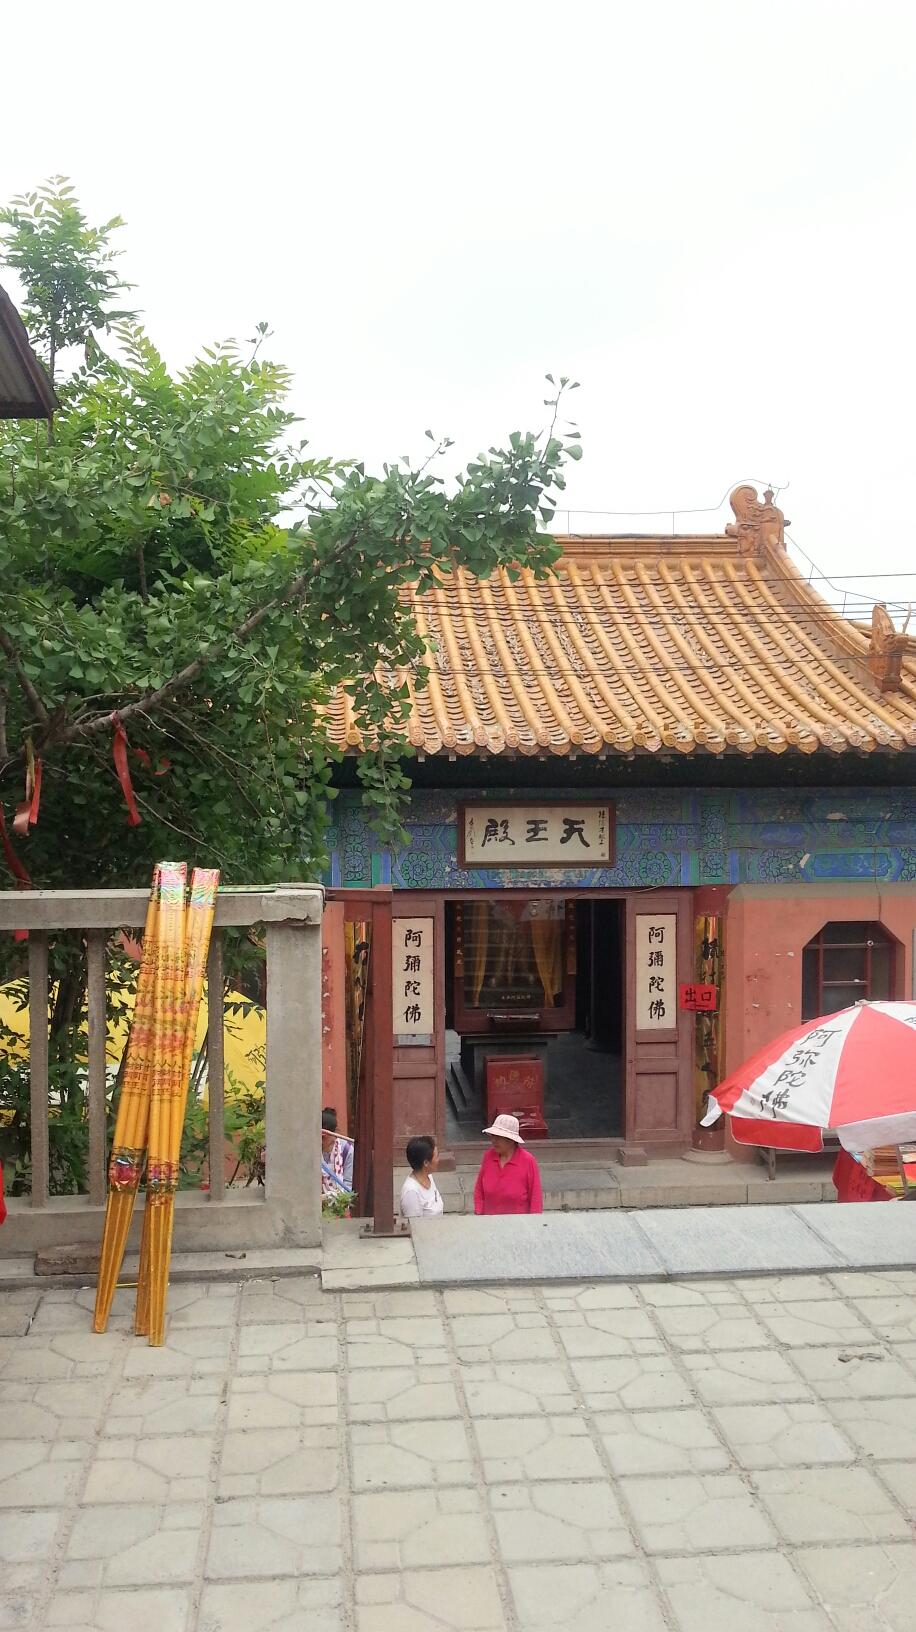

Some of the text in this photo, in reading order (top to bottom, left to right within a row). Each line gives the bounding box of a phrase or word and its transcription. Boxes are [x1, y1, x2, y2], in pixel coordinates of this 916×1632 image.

[481, 818, 590, 847] 天王殿
[403, 929, 423, 1024] 阿彌陀佛
[648, 926, 666, 1020] 阿彌陀佛
[684, 987, 712, 1003] 出口
[760, 1028, 842, 1118] 阿弥陀佛
